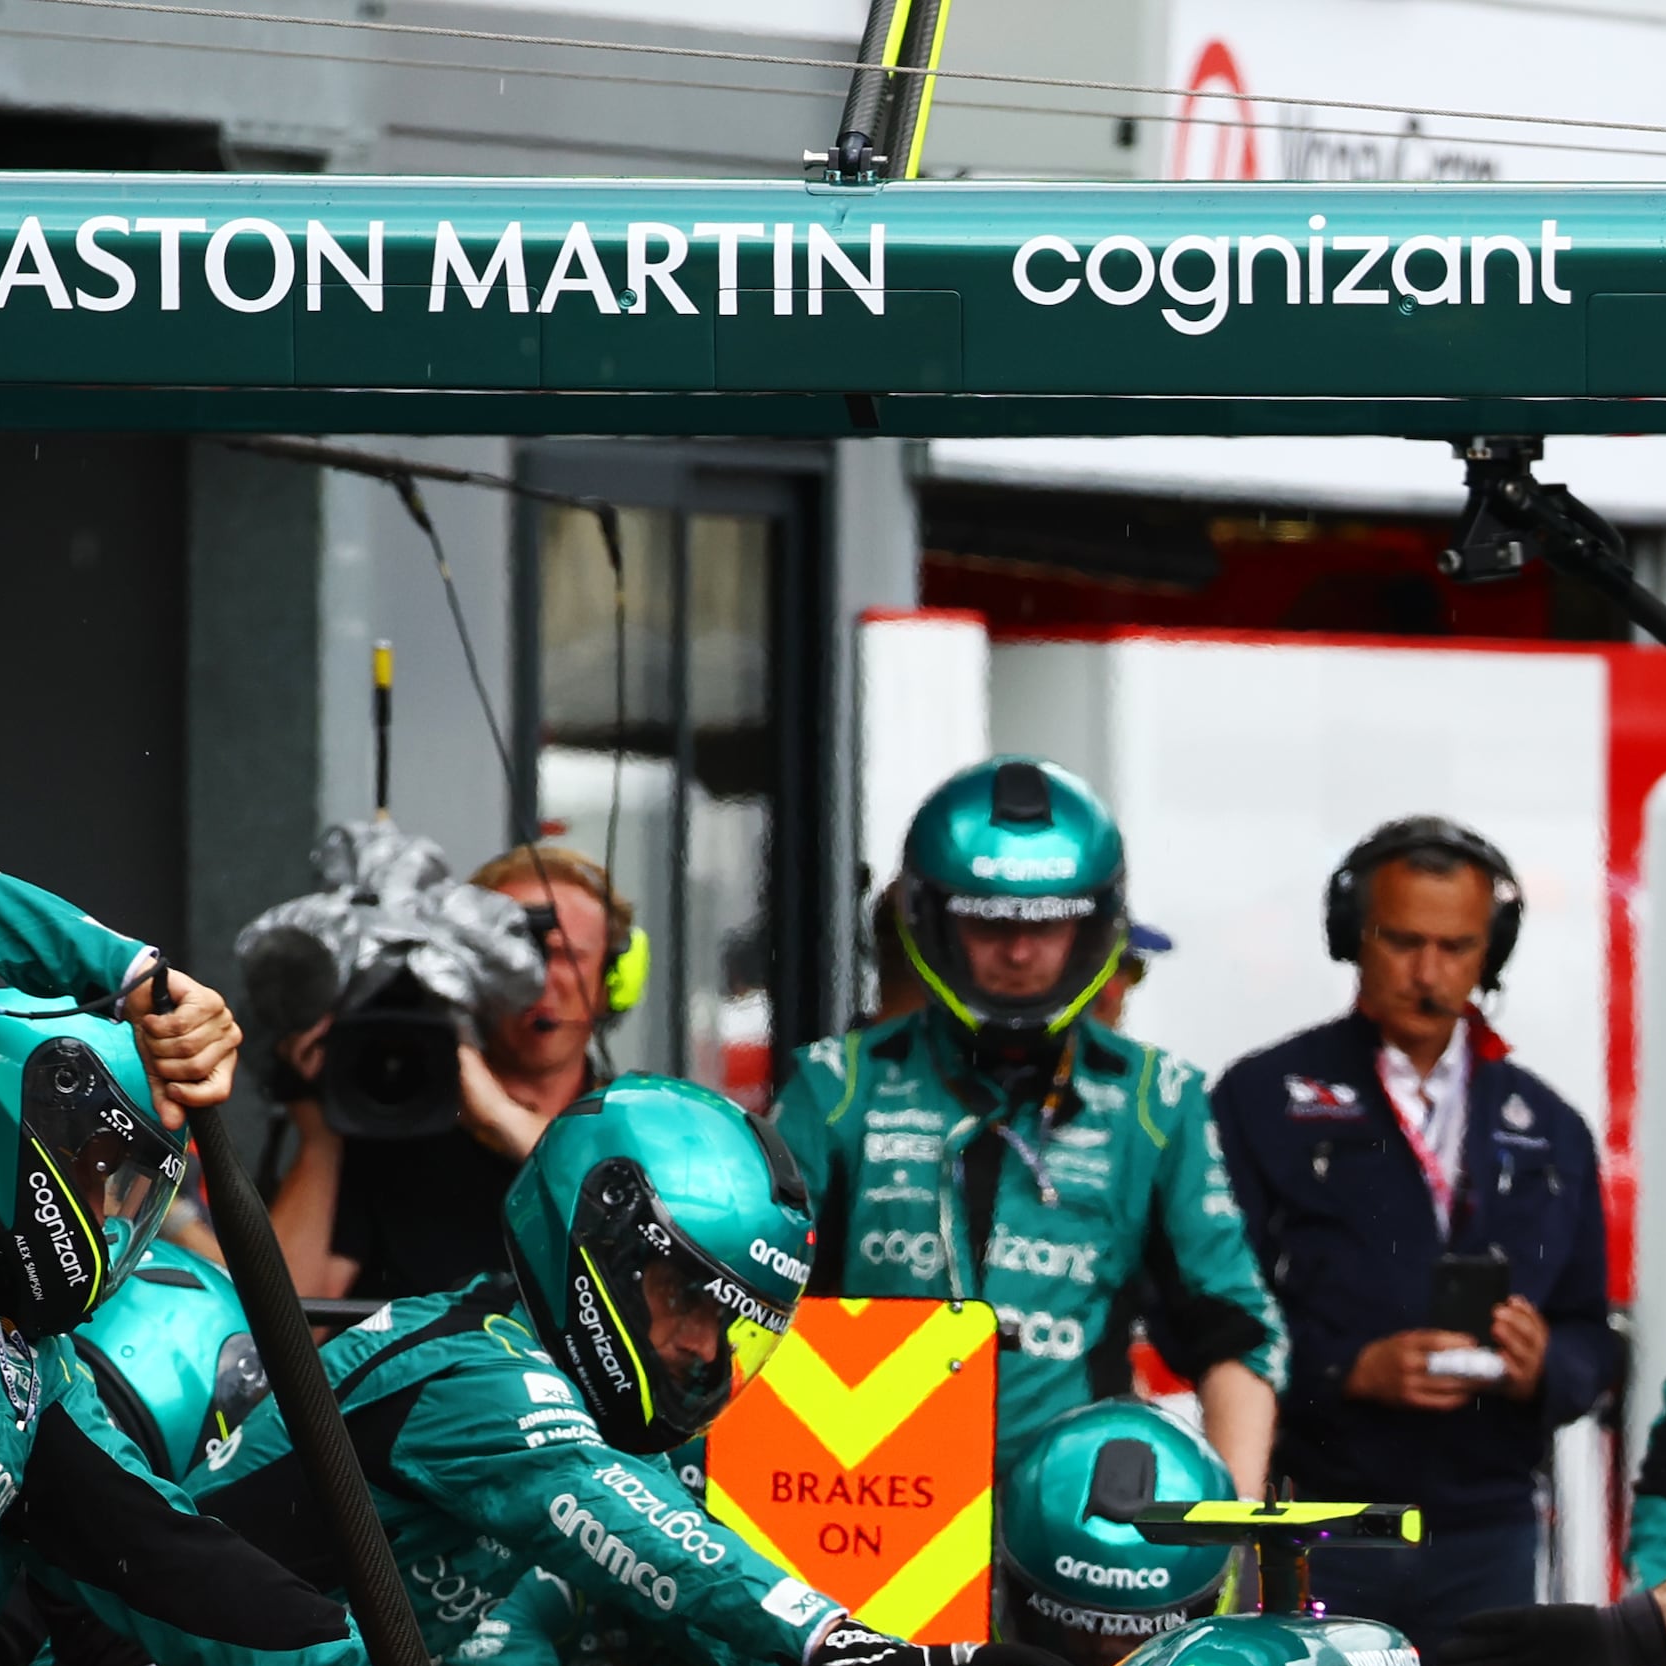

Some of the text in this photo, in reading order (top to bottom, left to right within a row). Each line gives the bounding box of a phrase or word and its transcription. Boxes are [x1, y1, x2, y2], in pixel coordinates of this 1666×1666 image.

[428, 220, 886, 317] MARTIN
[1012, 214, 1573, 336] cognizant
[100, 1110, 134, 1142] OAKLEY
[28, 1171, 89, 1288] cognizant
[14, 1234, 46, 1301] ALEX SIMPSON
[574, 1274, 633, 1393] cognizant
[704, 1277, 767, 1326] ASTON
[591, 1463, 726, 1565] cognizant
[771, 1471, 934, 1509] BRAKES
[549, 1492, 677, 1611] aramco
[818, 1522, 883, 1557] ON
[1055, 1554, 1170, 1590] aramco
[1027, 1591, 1189, 1636] ASTON MARTIN
